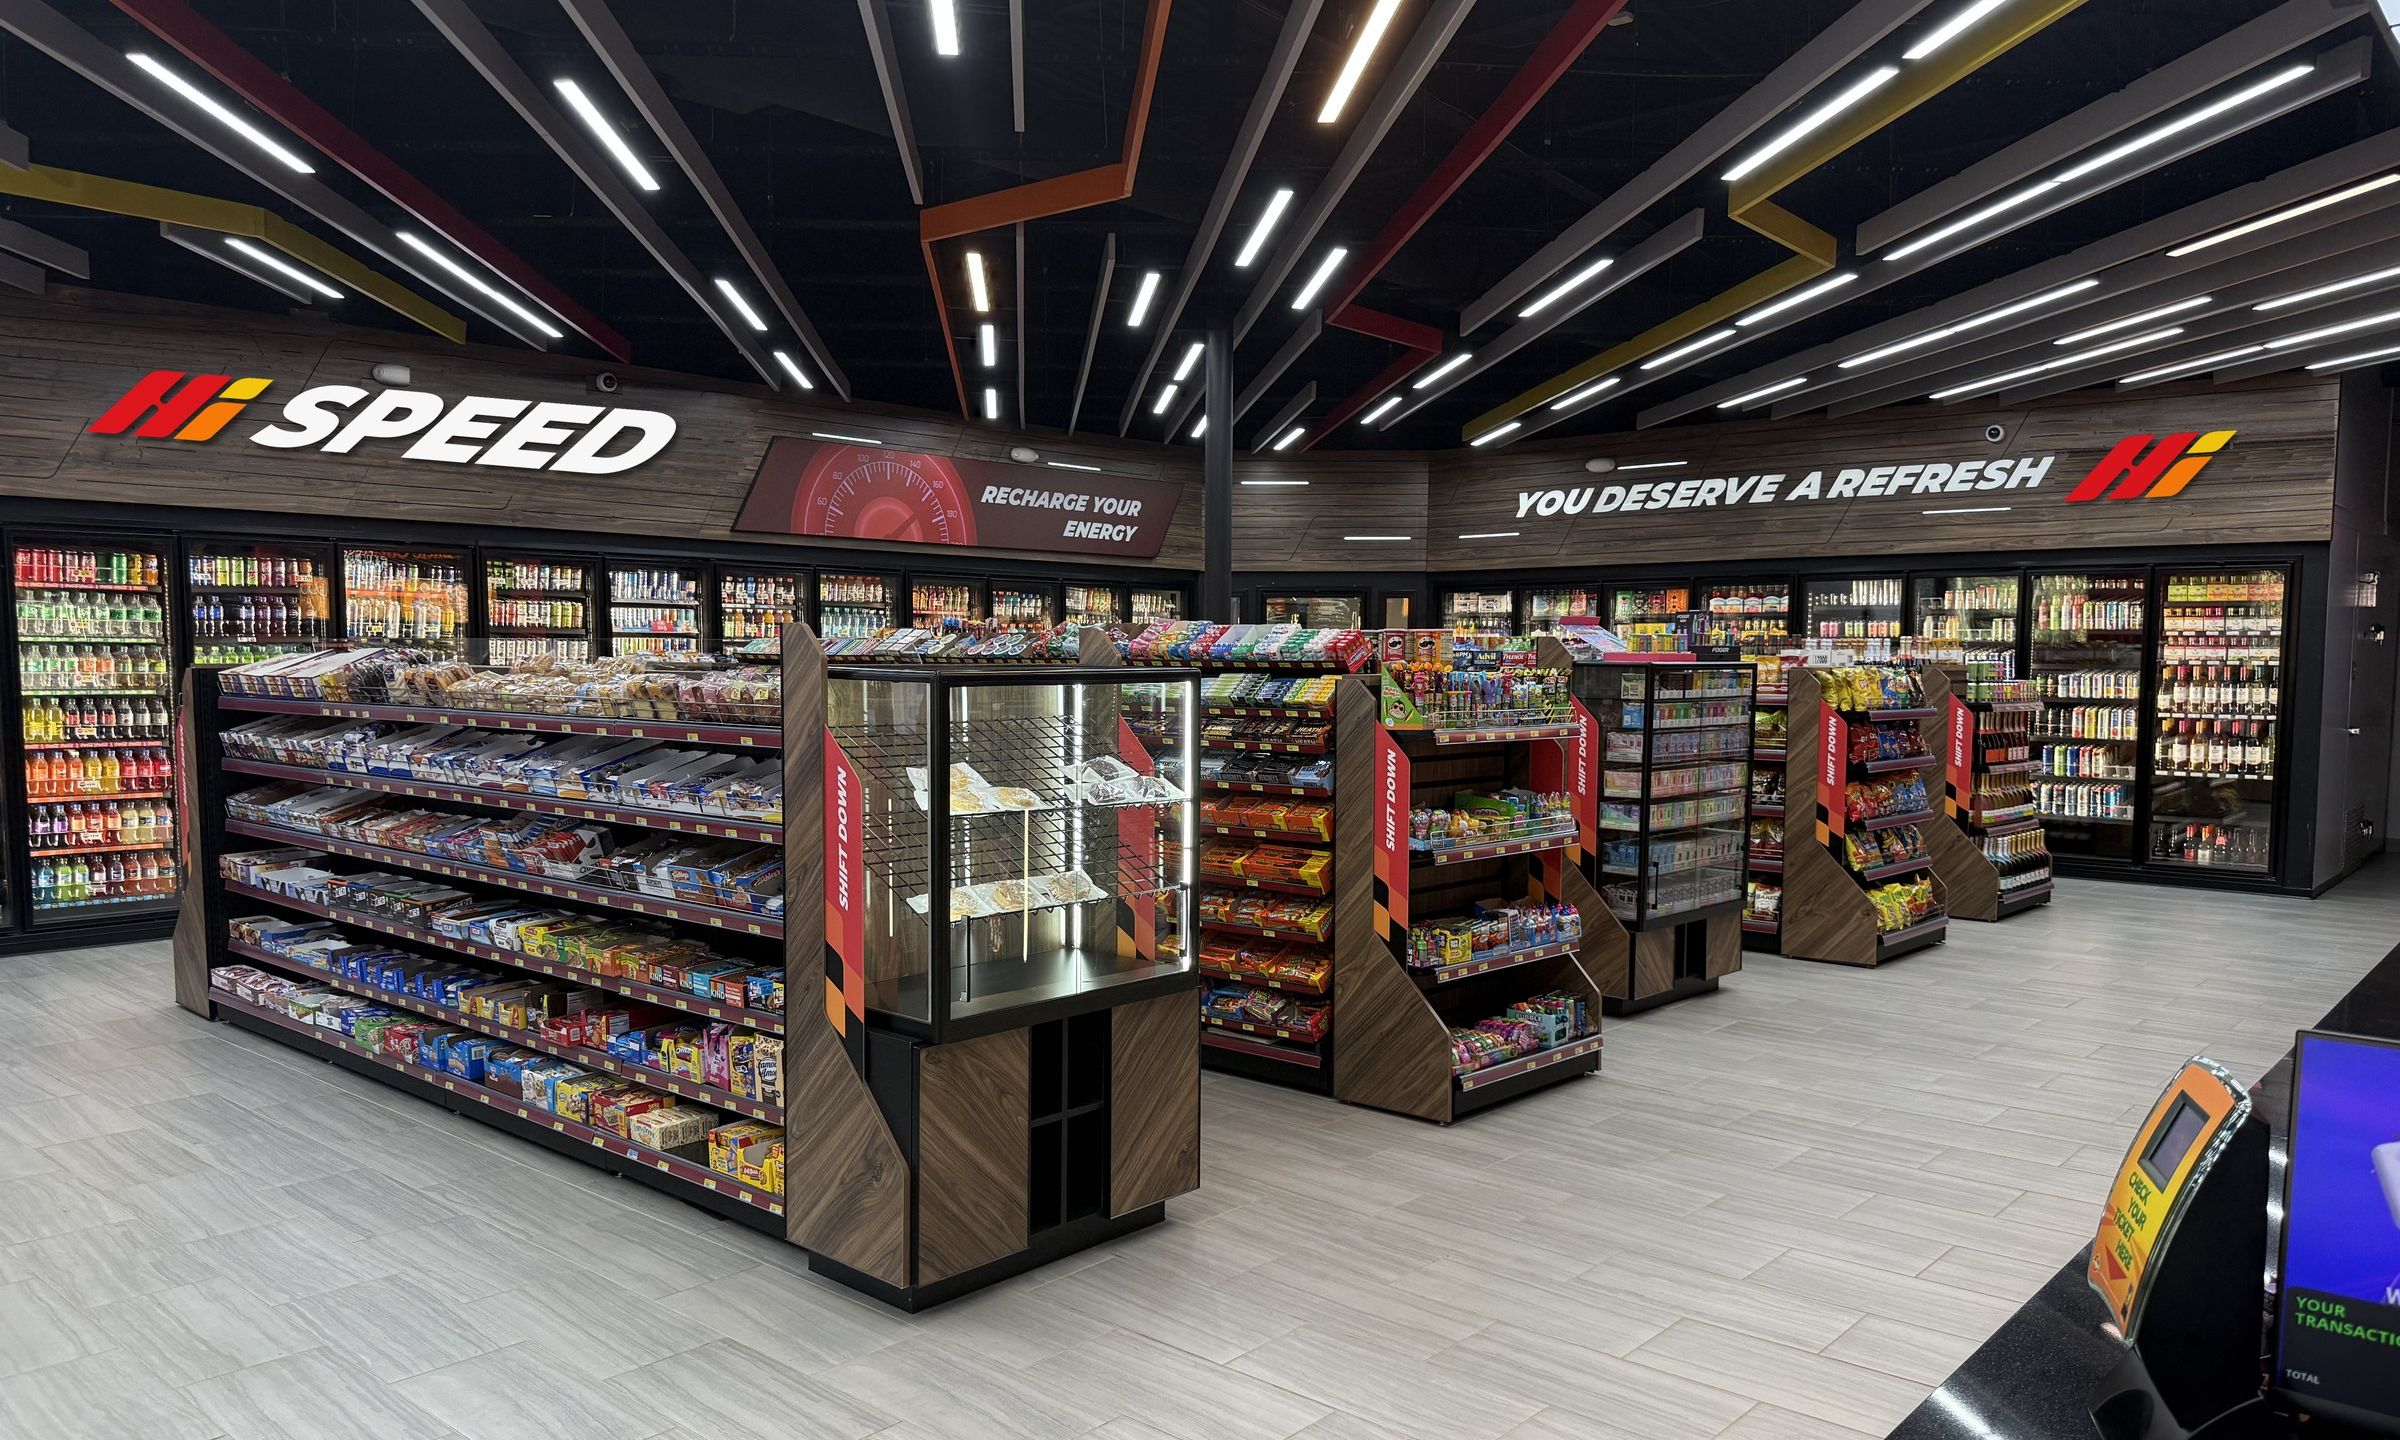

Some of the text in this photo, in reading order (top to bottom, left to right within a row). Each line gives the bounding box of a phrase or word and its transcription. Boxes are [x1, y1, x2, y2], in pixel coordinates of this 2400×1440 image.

[88, 370, 677, 474] Hi SPEED
[857, 454, 870, 463] 100
[883, 450, 895, 459] 120
[909, 460, 921, 469] 140
[832, 471, 843, 481] 80
[2064, 430, 2236, 502] Hi
[932, 480, 944, 489] 160
[1515, 456, 2056, 518] YOU DESERVE A REFRESH
[816, 496, 828, 506] 60
[980, 485, 1142, 517] RECHARGE YOUR
[946, 509, 958, 518] 180
[1062, 520, 1139, 542] ENERGY
[1476, 652, 1497, 661] Advil
[1502, 653, 1525, 661] TYLENOL
[1954, 707, 1965, 768] SHIFT DOWN
[1577, 713, 1588, 796] SHIFT DOWN
[1826, 715, 1837, 786] SHIFT DOWN
[1386, 748, 1397, 852] SHIFT DOWN
[837, 765, 849, 912] SHIFT DOWN
[650, 972, 663, 983] KIND
[679, 979, 693, 990] KIND
[710, 988, 725, 1000] KIND
[2128, 1171, 2152, 1206] CHECK
[2113, 1206, 2135, 1243] TICKET
[2127, 1196, 2147, 1232] YOUR
[2114, 1238, 2134, 1273] HERE
[2296, 1296, 2346, 1318] YOUR
[2286, 1368, 2320, 1385] TOTAL
